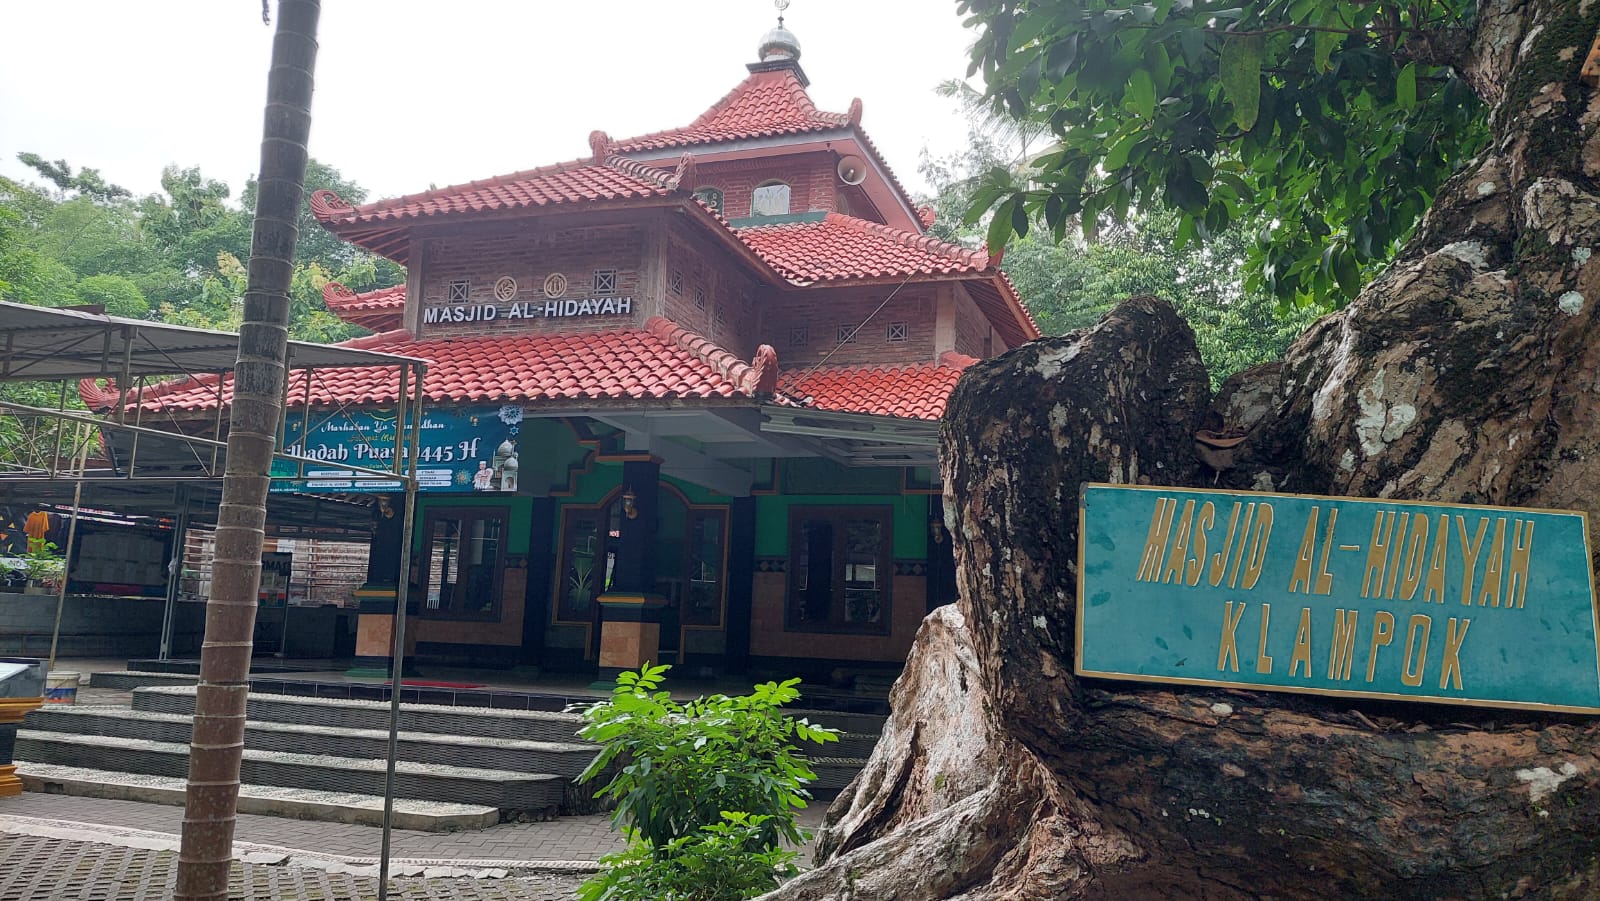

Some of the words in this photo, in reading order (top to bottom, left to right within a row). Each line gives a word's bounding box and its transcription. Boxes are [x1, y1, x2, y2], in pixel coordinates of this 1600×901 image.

[423, 305, 497, 324] MASJID
[508, 297, 631, 319] AL-HIDAYAH
[374, 420, 388, 433] Ya
[457, 438, 480, 461] H
[1136, 498, 1274, 587] MASJID
[1288, 505, 1535, 609] AL-HIDAYAH
[1217, 601, 1471, 691] KLAMPOK
